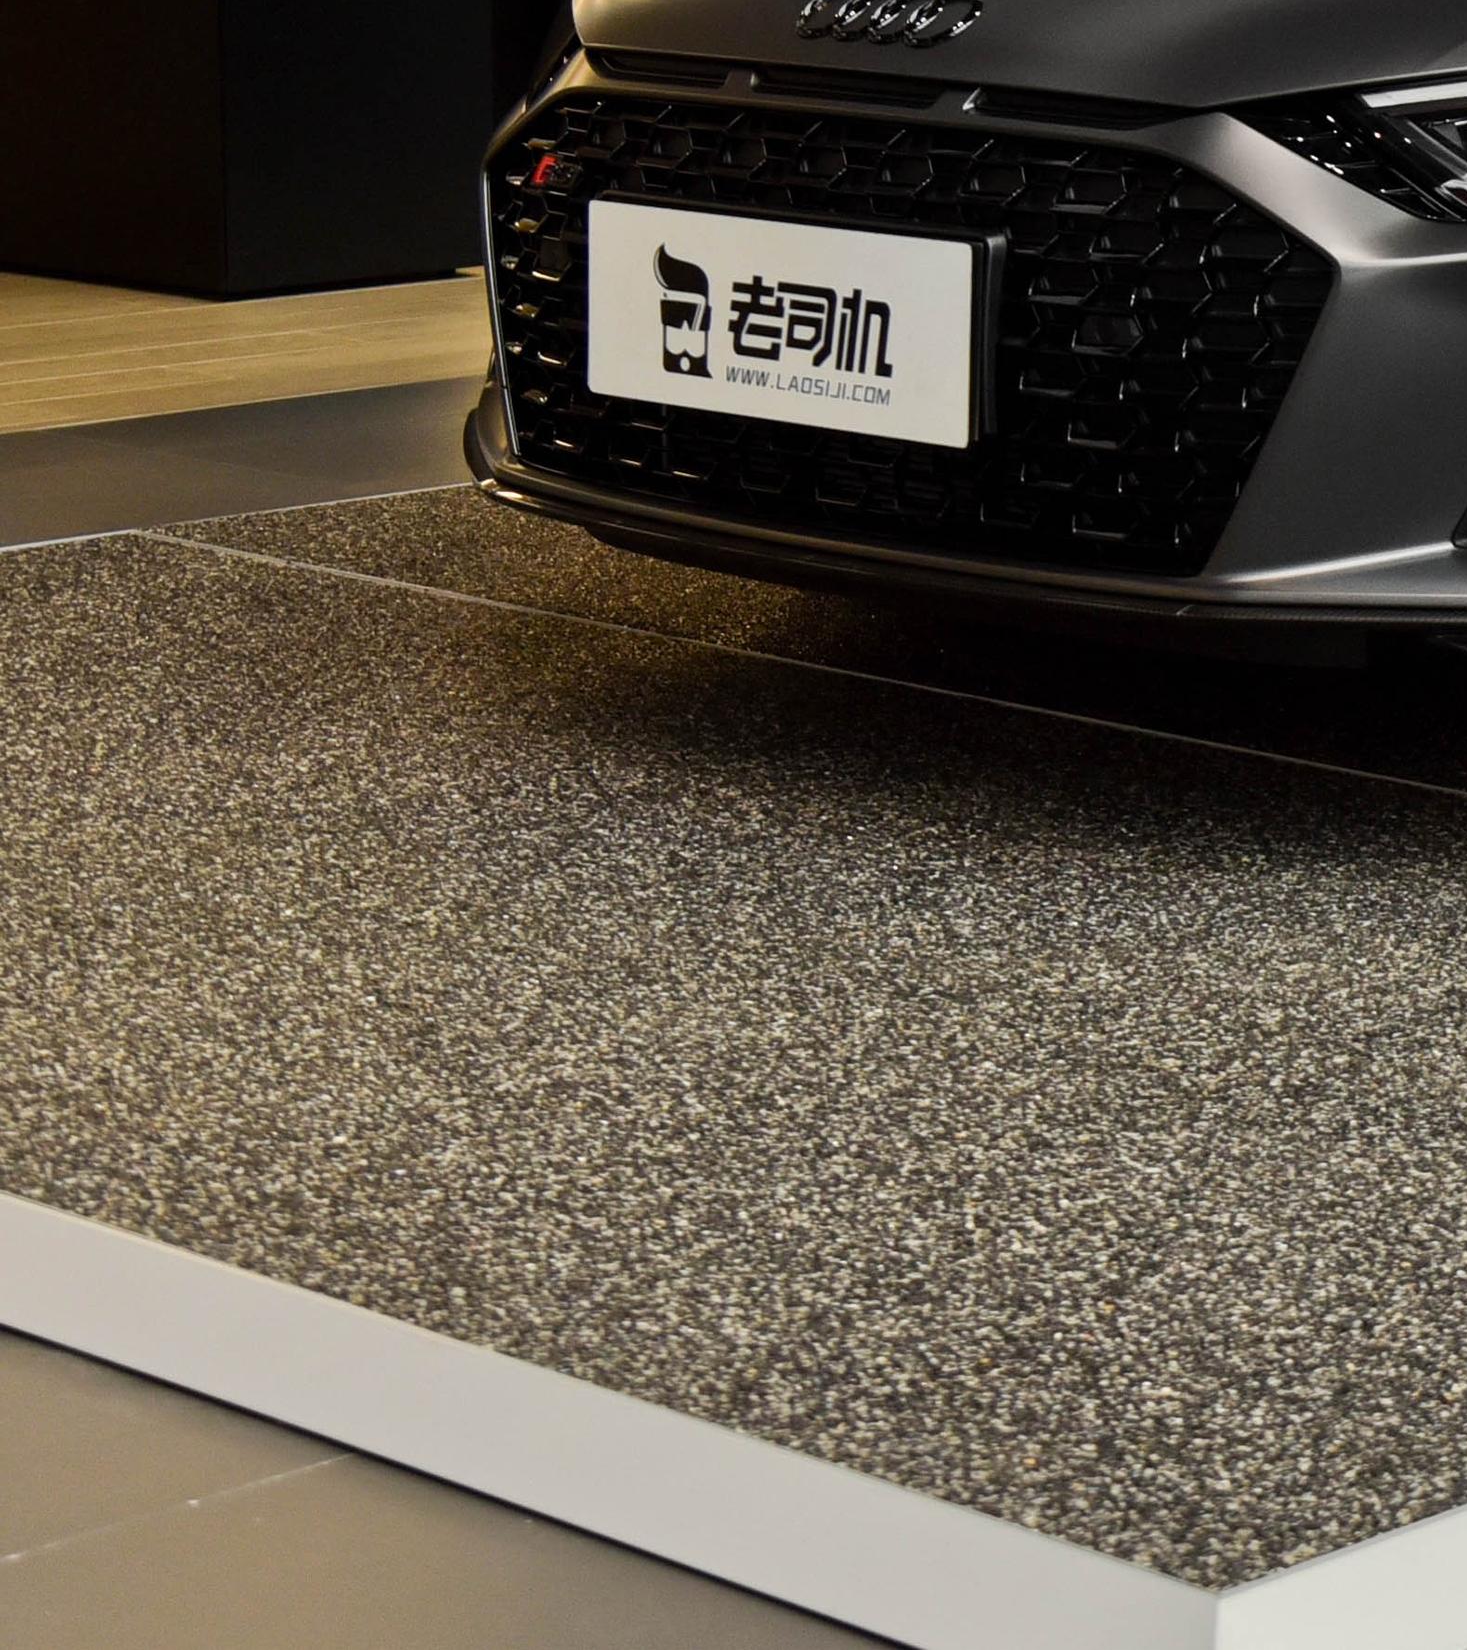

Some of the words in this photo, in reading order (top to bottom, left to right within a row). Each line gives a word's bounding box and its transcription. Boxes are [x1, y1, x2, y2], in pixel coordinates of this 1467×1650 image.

[728, 275, 894, 379] 老司机
[725, 365, 892, 407] WWW.LAOSIJI.COM
